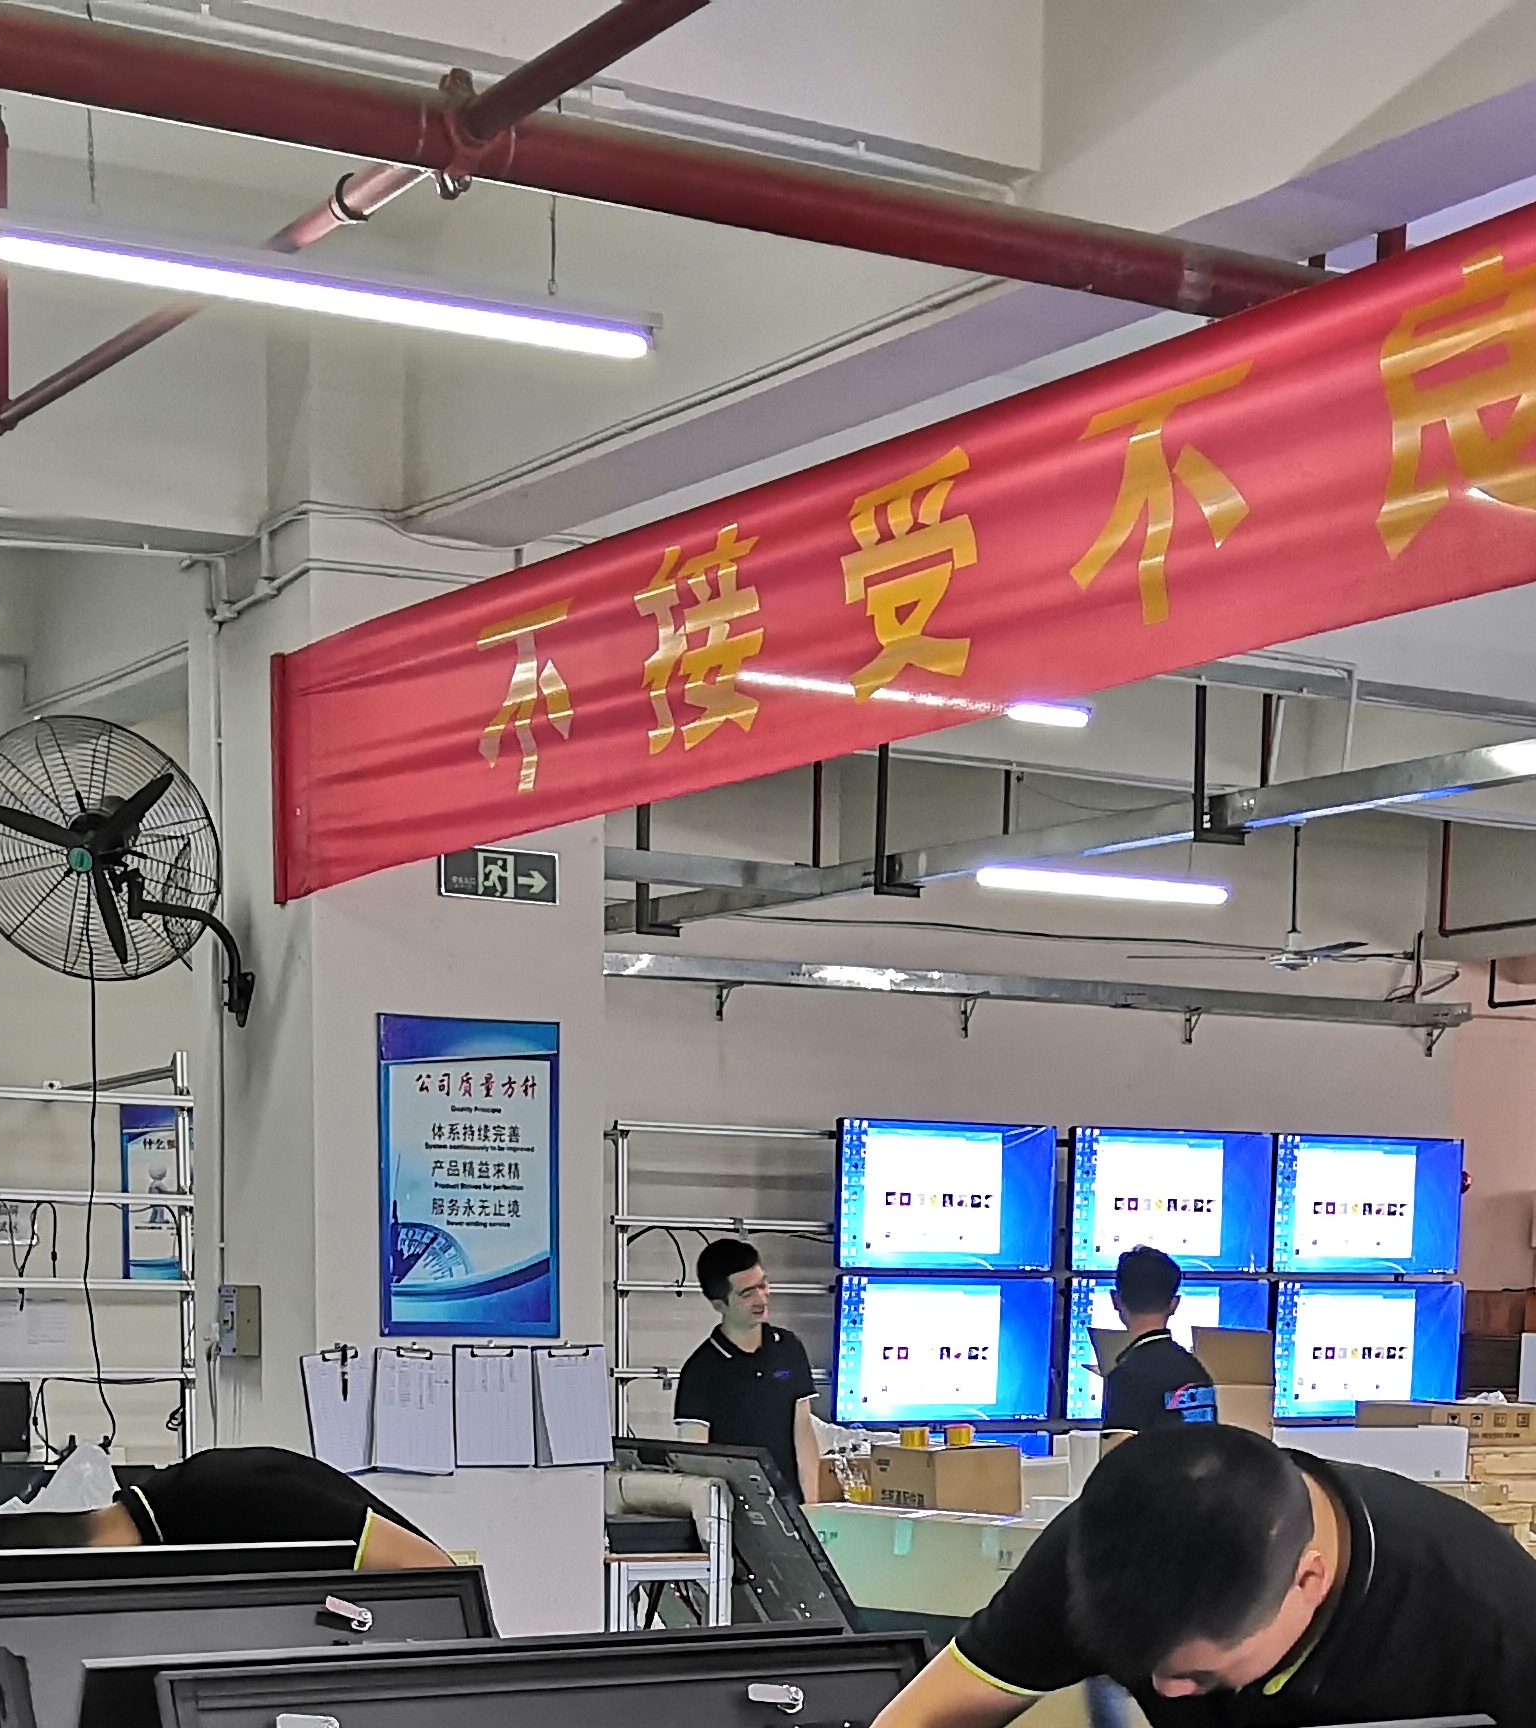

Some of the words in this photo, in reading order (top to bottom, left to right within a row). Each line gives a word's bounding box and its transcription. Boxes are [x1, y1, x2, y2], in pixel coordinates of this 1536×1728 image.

[416, 1072, 537, 1099] 公司质量方针
[431, 1122, 521, 1144] 体系持续完善
[431, 1159, 520, 1180] 产品精益求精
[431, 1197, 521, 1218] 服务永无止境
